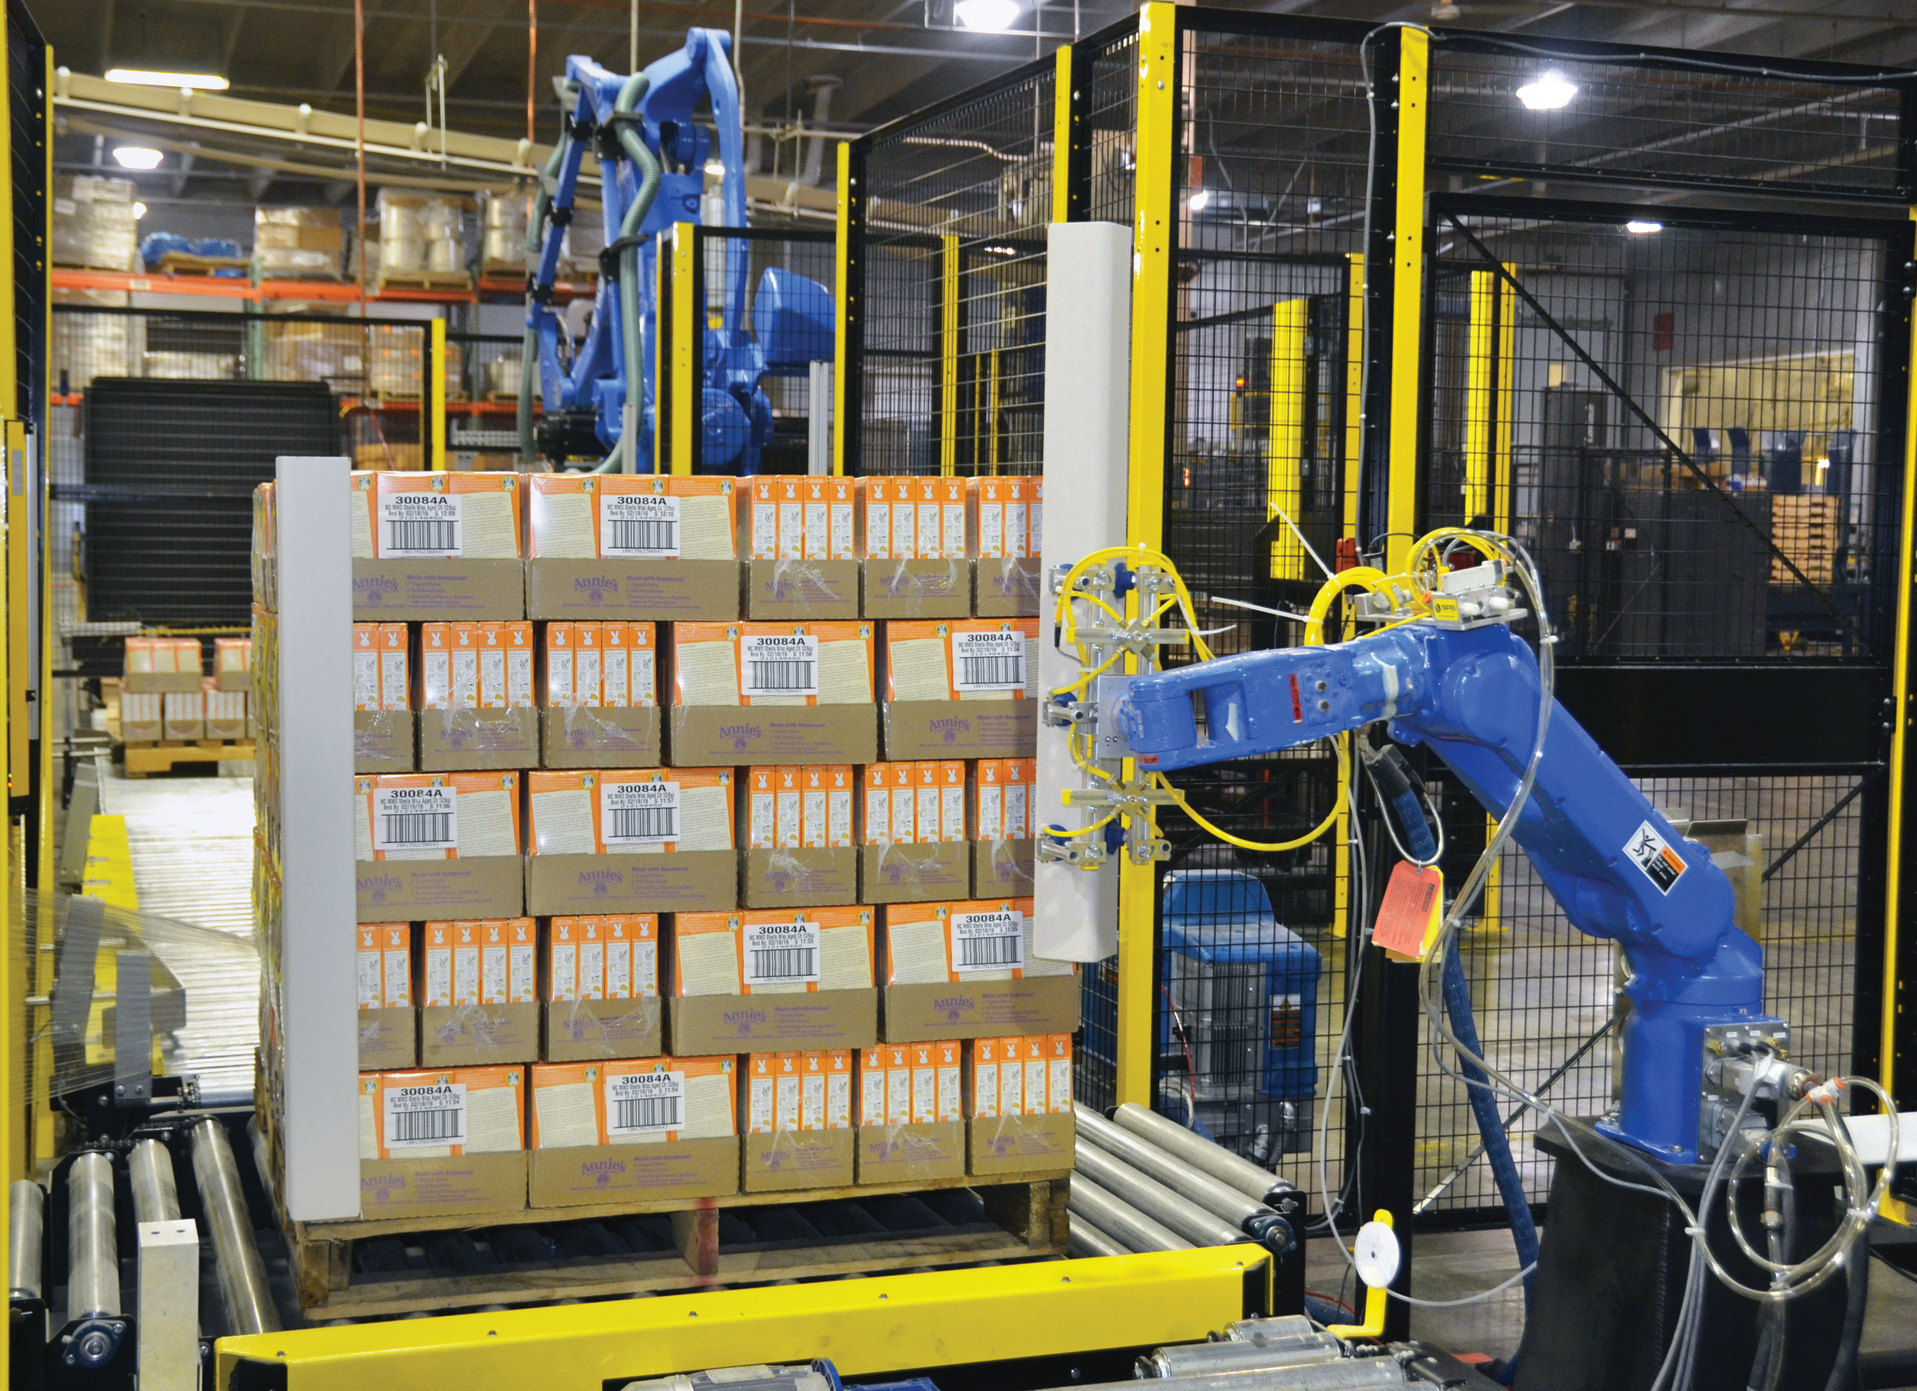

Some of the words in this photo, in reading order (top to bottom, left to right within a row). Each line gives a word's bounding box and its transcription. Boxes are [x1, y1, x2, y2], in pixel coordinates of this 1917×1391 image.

[396, 496, 448, 504] 30084A
[352, 575, 399, 592] Annie's
[575, 575, 619, 592] Annie's
[720, 722, 762, 738] Annie's
[930, 716, 970, 732] Annie's
[390, 790, 442, 798] 30084A
[618, 784, 666, 792] 30084A
[356, 874, 402, 891] Annie's
[578, 867, 624, 884] Annie's
[966, 914, 1012, 924] 30084A
[758, 926, 806, 934] 30084A
[934, 995, 974, 1011] Annie's
[724, 1008, 766, 1024] Annie's
[622, 1074, 670, 1084] 30084A
[400, 1086, 452, 1096] 30084A
[582, 1158, 626, 1175] Annie's
[361, 1172, 406, 1190] Annie's
